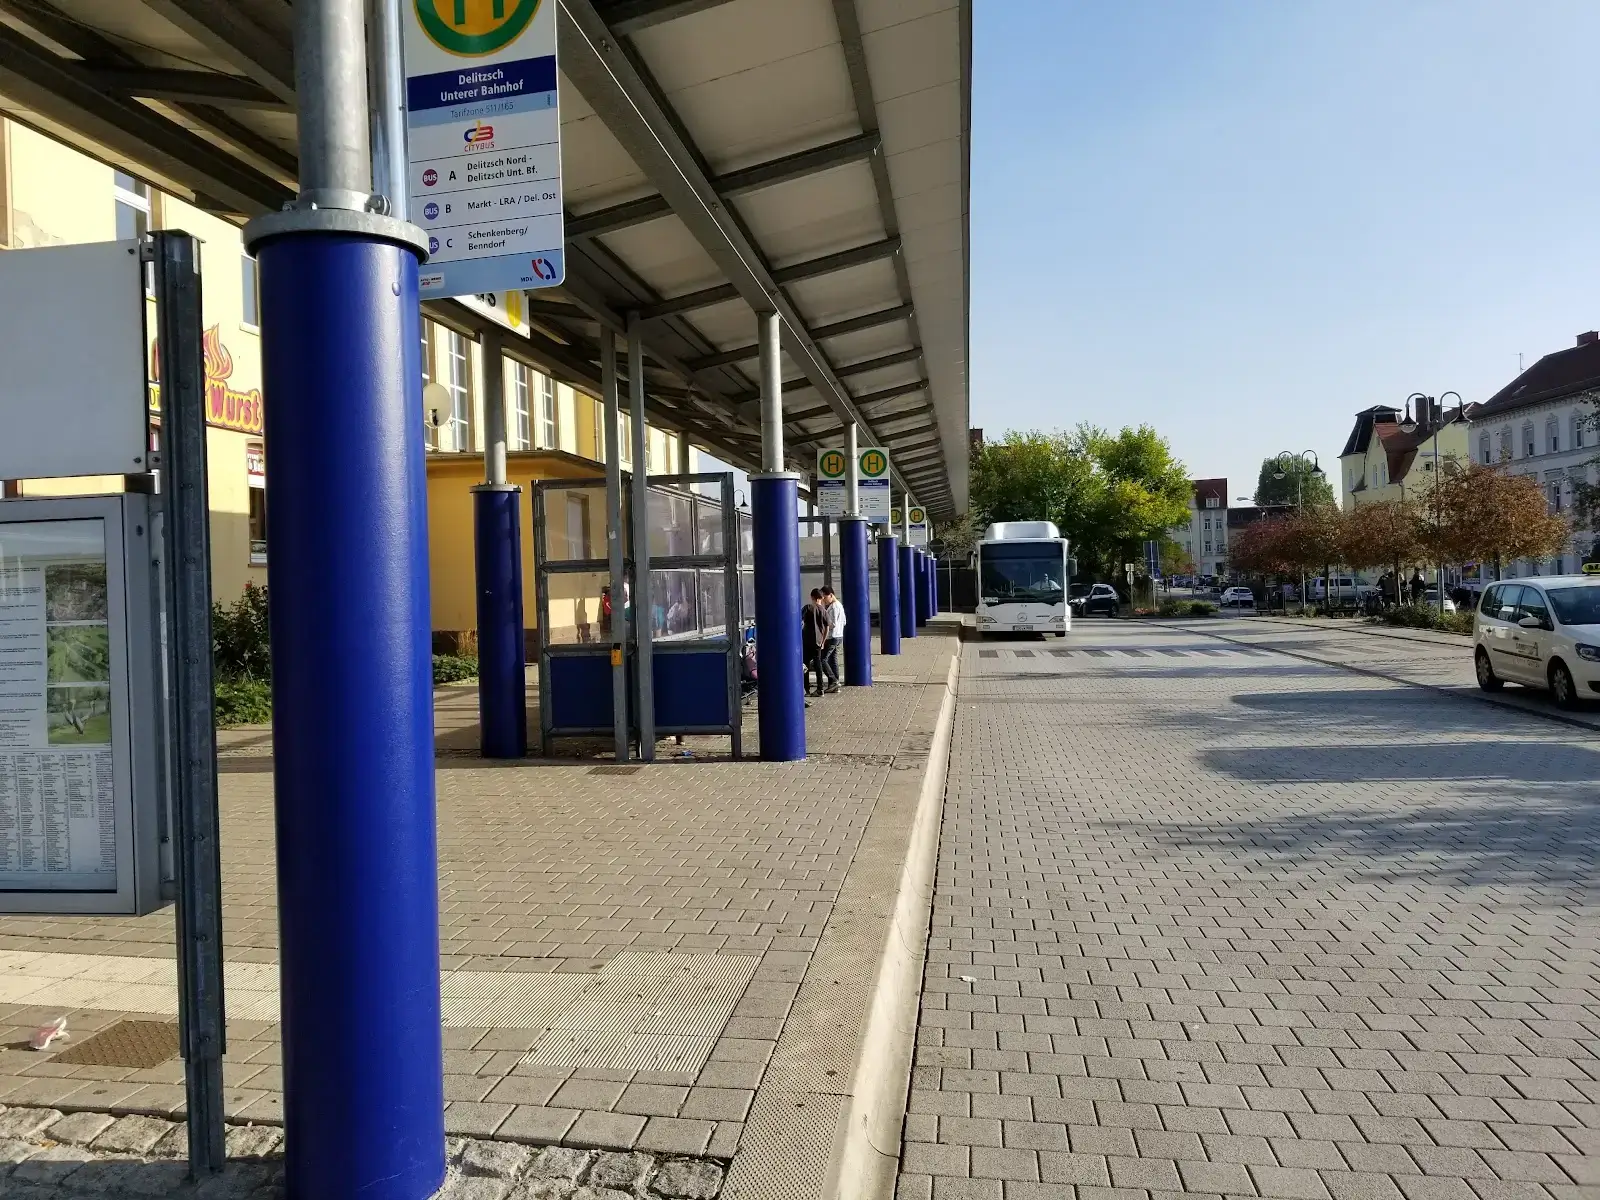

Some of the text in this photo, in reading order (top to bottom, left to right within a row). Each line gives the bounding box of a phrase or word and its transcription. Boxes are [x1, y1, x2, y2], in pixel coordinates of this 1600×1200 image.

[458, 69, 504, 85] Delitzsch
[440, 79, 524, 102] Unterer Bahnhof
[450, 107, 484, 119] Tarifzone
[463, 141, 495, 152] CITYBUS
[467, 159, 504, 171] Delitzsch
[506, 155, 527, 165] Nord
[423, 174, 438, 182] BUS
[448, 170, 457, 181] A
[467, 165, 538, 183] Delitzsch Unt. Bf.
[467, 200, 492, 210] Markt
[499, 198, 516, 206] LRA
[524, 194, 540, 203] Del.
[542, 192, 556, 201] Ost
[424, 207, 439, 216] BUS
[445, 203, 452, 214] B
[467, 226, 529, 239] Schenkenberg/
[446, 238, 453, 248] C
[468, 240, 506, 251] Benndorf
[210, 383, 259, 426] Wurst
[828, 456, 839, 472] H
[868, 455, 878, 471] H
